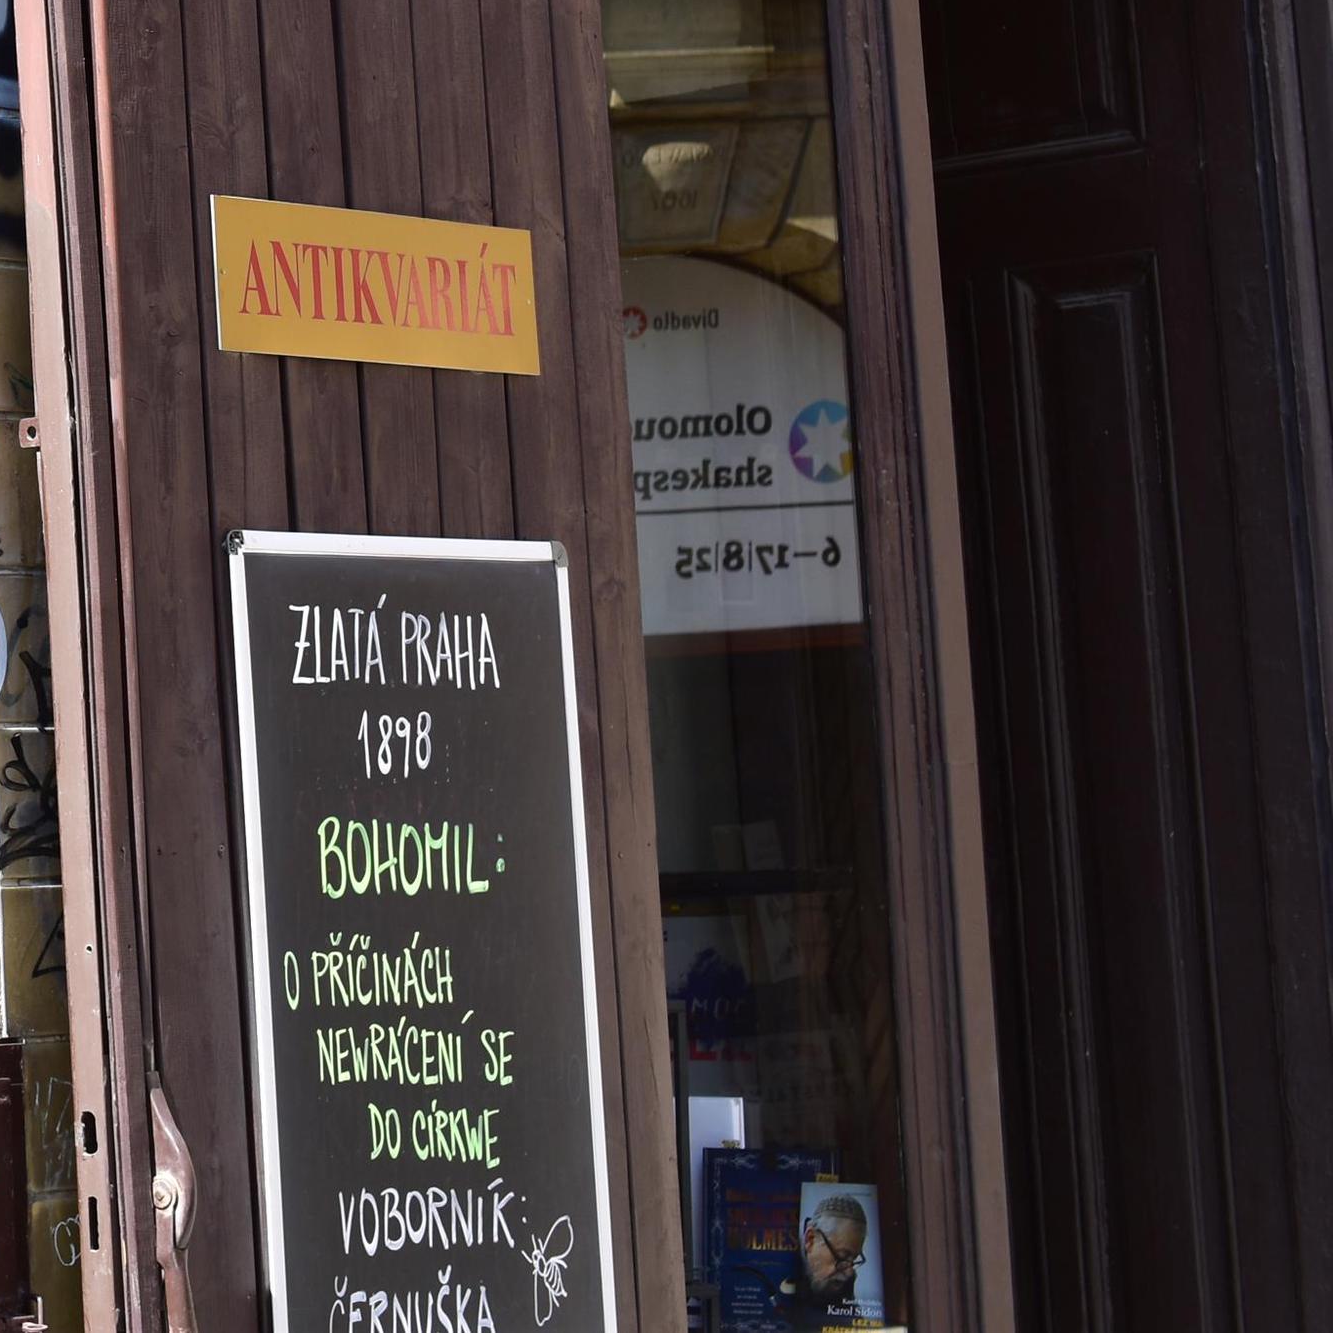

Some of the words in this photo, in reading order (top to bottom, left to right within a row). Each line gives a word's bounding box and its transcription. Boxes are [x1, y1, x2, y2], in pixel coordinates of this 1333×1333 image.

[238, 238, 518, 337] ANTIKVARIÁT
[288, 593, 387, 685] ZLATÁ
[400, 610, 501, 691] PRAHA
[357, 709, 433, 780] 1898
[317, 815, 506, 900] BOHOMIL:
[283, 950, 301, 1011] O
[311, 931, 454, 1009] PŘÍČINÁCH
[479, 1029, 515, 1087] SE
[367, 1102, 402, 1161] DO
[411, 1099, 501, 1169] CÍRKWE
[328, 1265, 497, 1333] ČERNUŠKA
